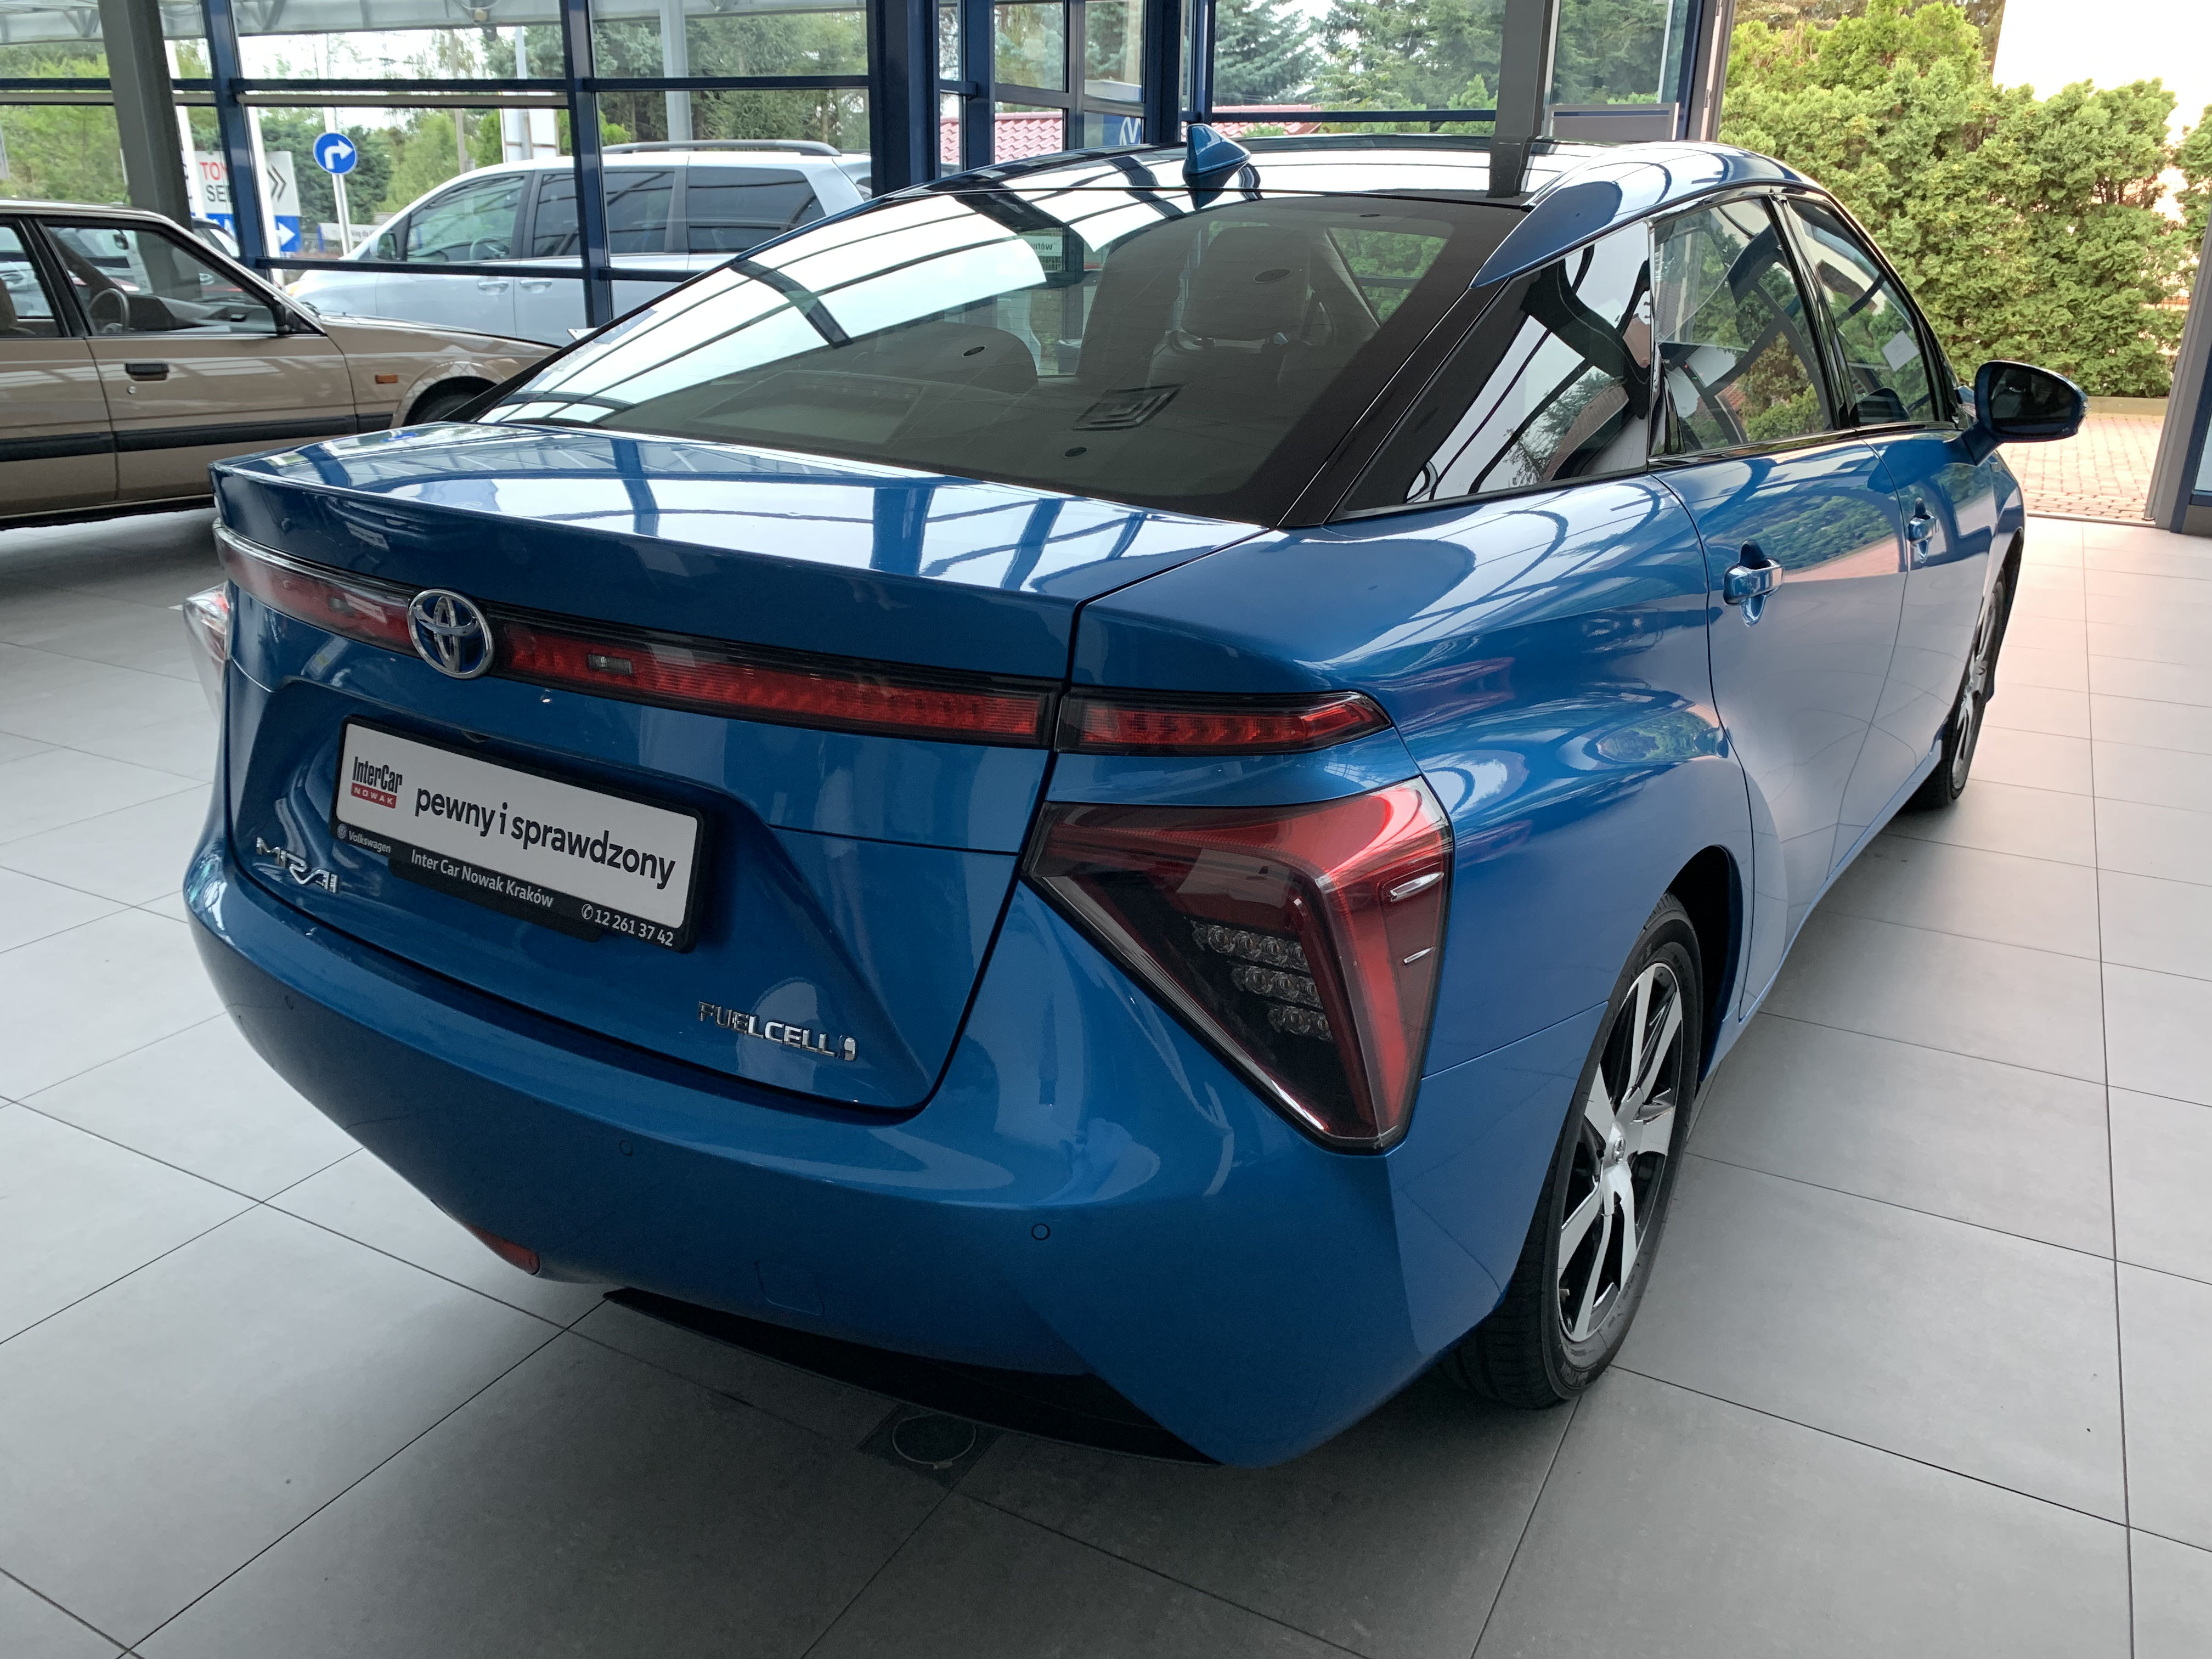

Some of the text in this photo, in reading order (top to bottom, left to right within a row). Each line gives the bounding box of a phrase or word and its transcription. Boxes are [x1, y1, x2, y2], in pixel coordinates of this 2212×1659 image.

[352, 756, 403, 793] InterCar
[354, 787, 393, 805] NOWAK
[349, 831, 391, 853] Volkswagen
[415, 788, 676, 890] pewny i sprawdzony
[411, 849, 554, 907] Inter Car Nowak Kraków
[594, 910, 673, 946] 12 261 37 42
